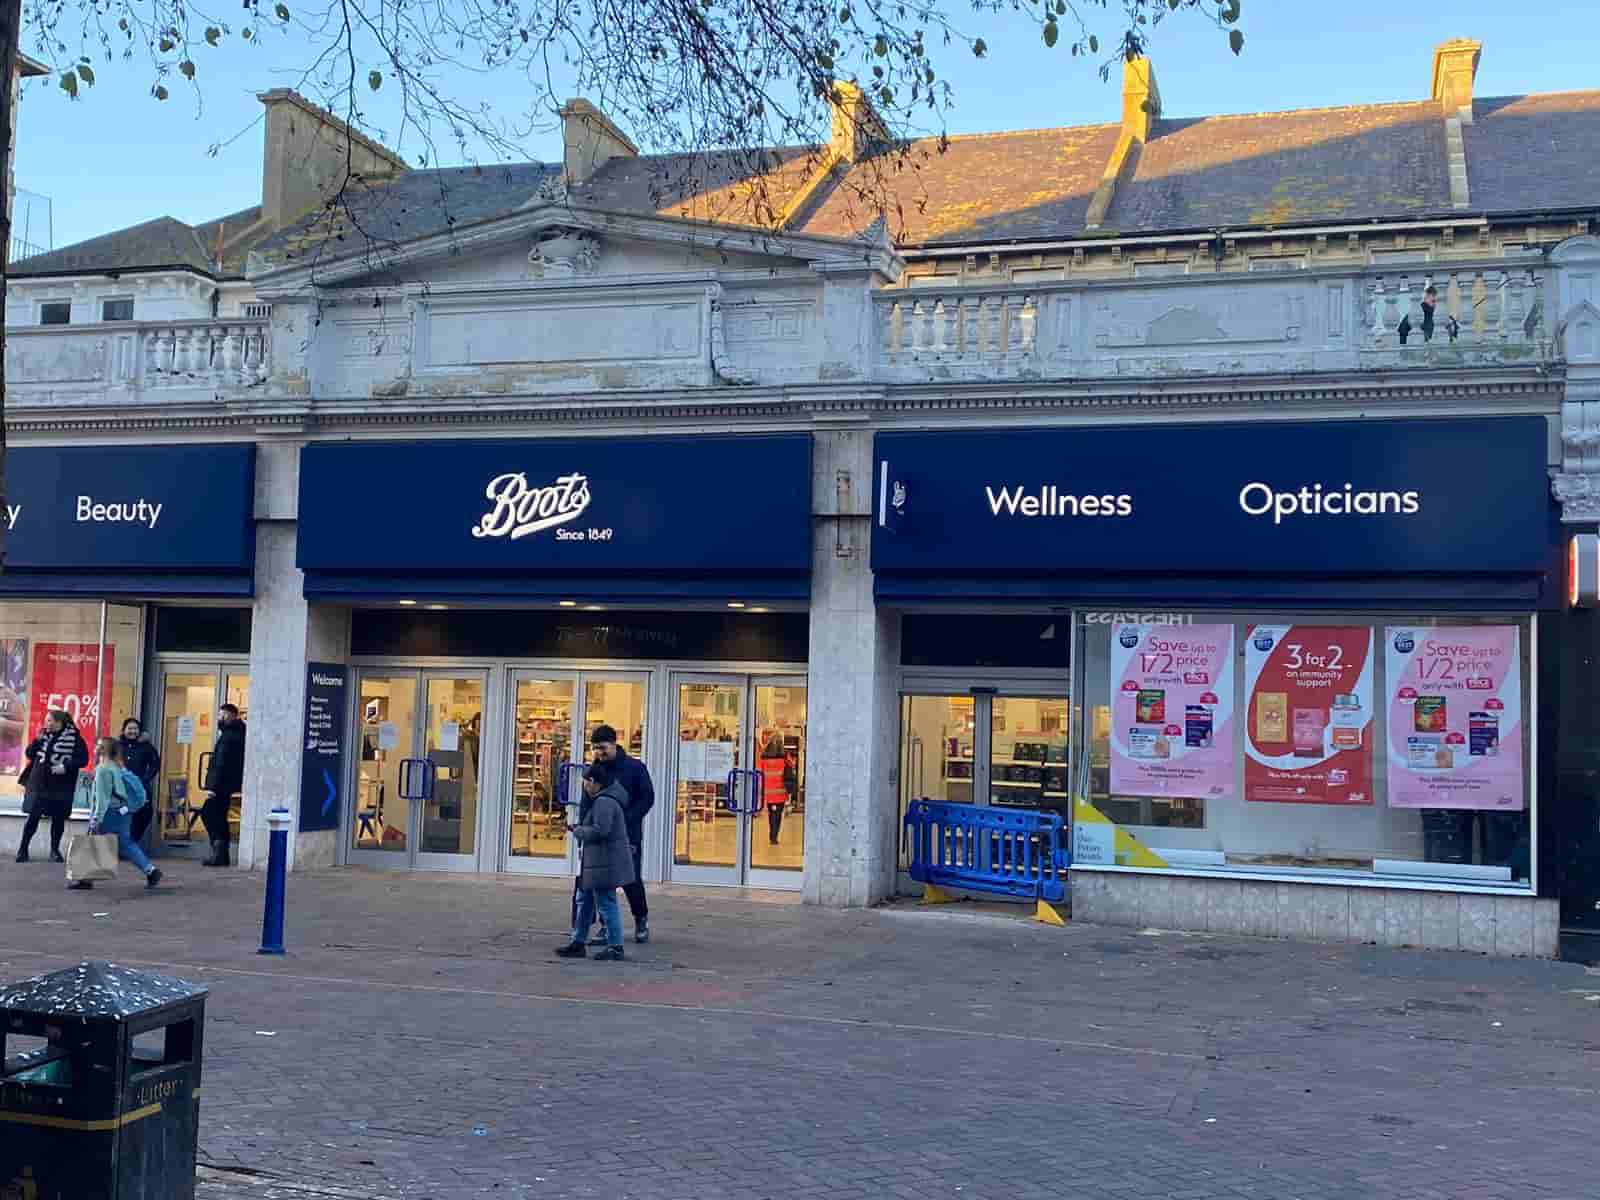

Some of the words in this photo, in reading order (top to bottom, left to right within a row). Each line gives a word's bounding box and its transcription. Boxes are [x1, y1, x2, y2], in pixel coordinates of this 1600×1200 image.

[472, 472, 592, 540] Boots
[985, 486, 1132, 516] Wellness
[1239, 482, 1419, 524] Opticians
[76, 495, 162, 529] Beauty
[555, 528, 585, 541] Since
[588, 528, 613, 541] 1849
[1149, 636, 1188, 653] Save
[1425, 640, 1472, 657] Save
[1140, 653, 1173, 674] 1/2
[1176, 655, 1209, 669] price
[1287, 644, 1303, 669] 3
[1306, 652, 1326, 665] for
[1327, 645, 1344, 669] 2
[312, 672, 343, 686] Welcome
[1300, 670, 1343, 681] immunity
[1416, 657, 1455, 680] 1/2
[1296, 679, 1331, 688] support
